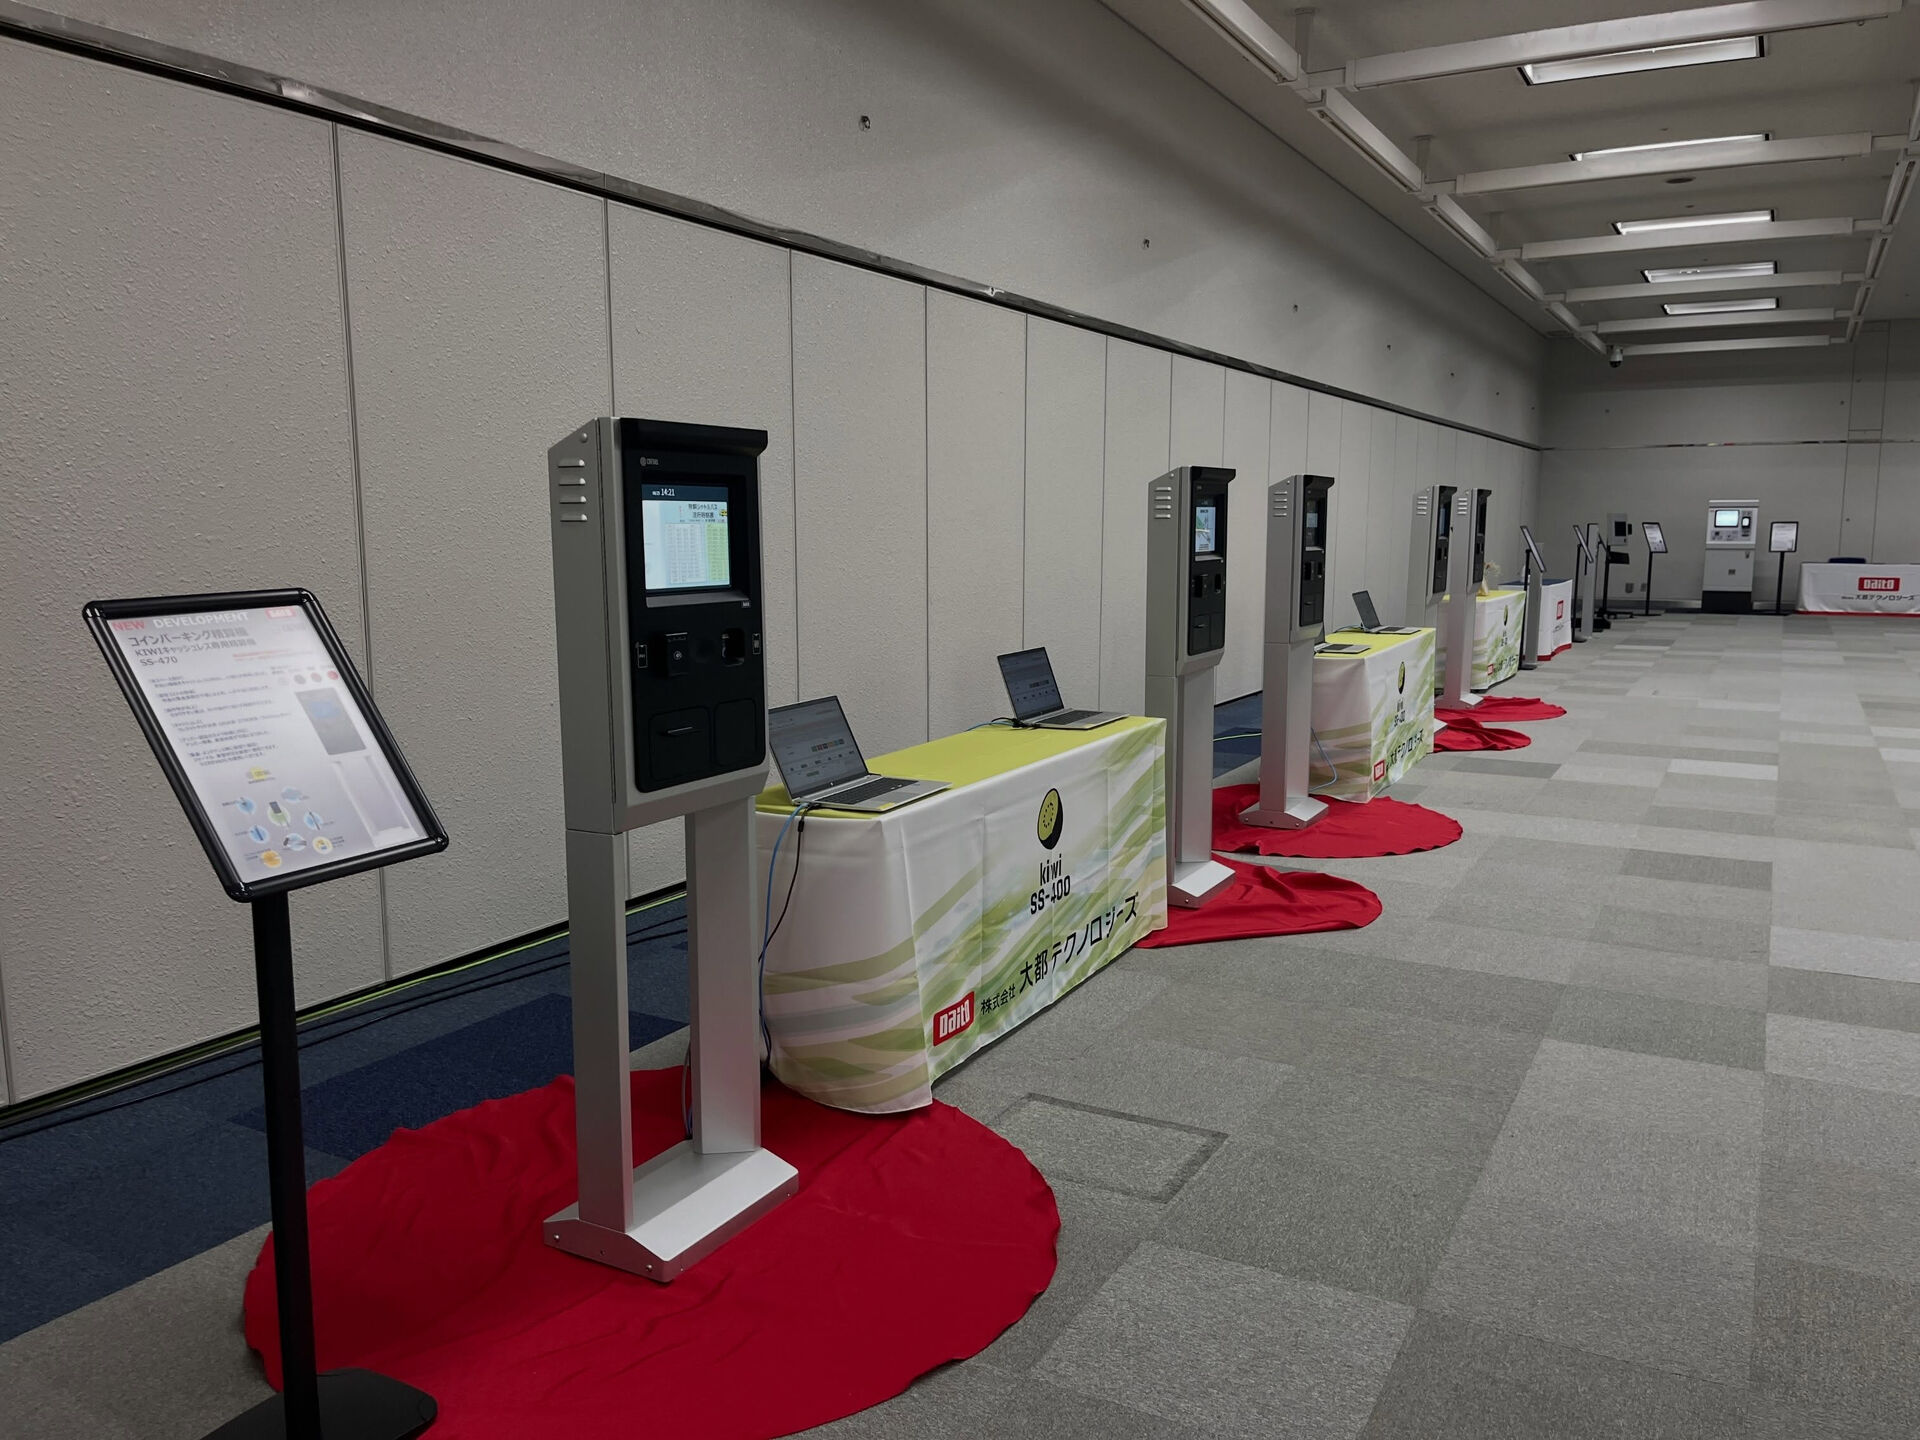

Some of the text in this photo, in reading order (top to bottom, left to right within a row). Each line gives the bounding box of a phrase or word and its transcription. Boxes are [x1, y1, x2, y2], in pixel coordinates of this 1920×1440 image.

[112, 612, 249, 632] NEW DEVELOPMENT
[140, 656, 178, 667] SS-470
[1039, 853, 1062, 886] kiwi
[1030, 875, 1071, 915] SS-400
[980, 891, 1139, 1016] 株式会社 大都テクノロジーズ
